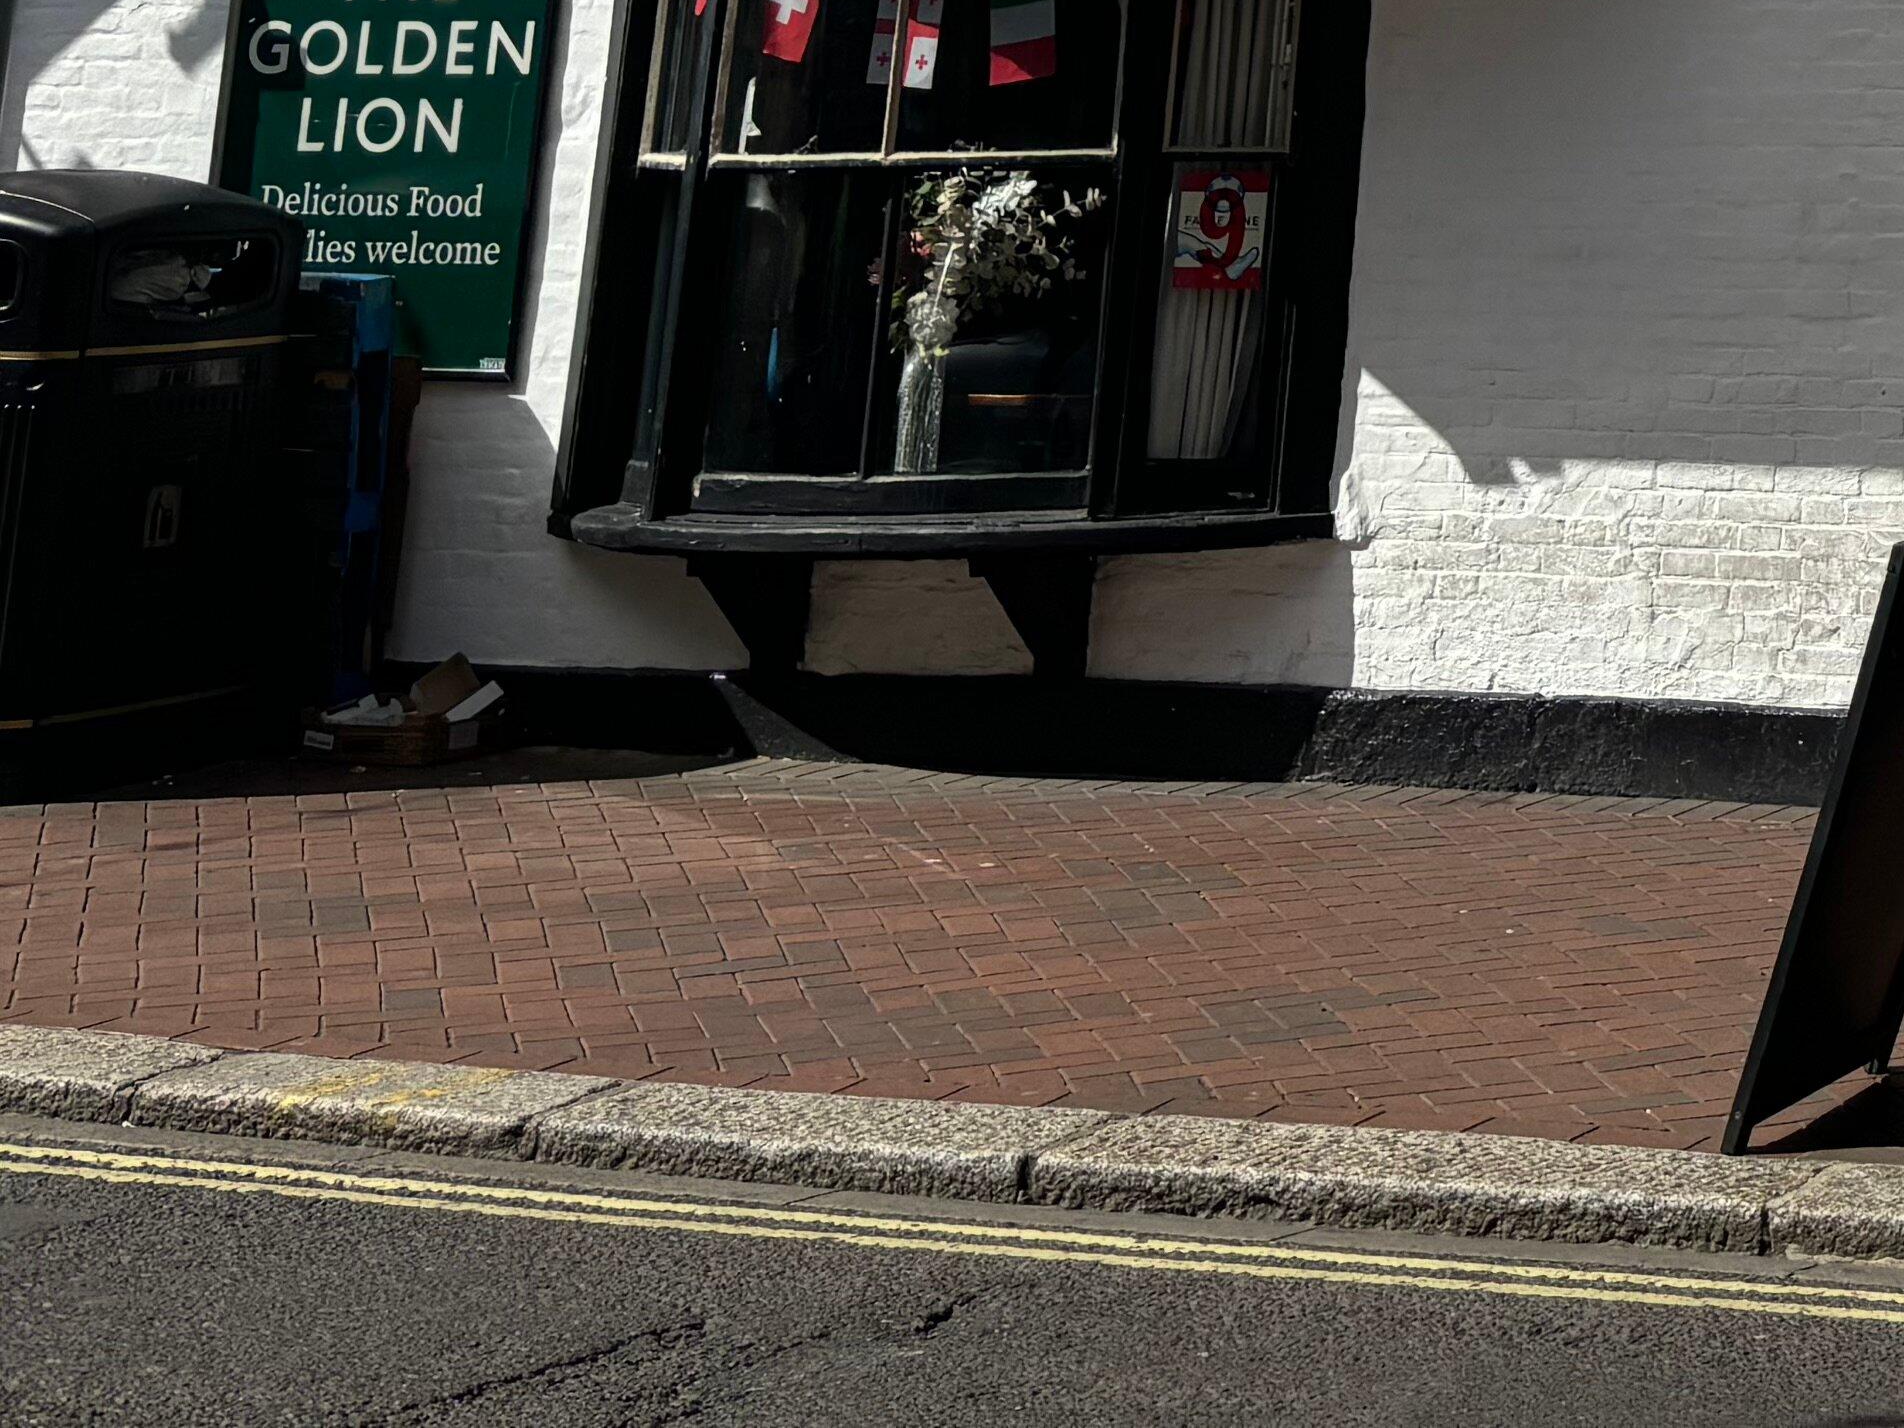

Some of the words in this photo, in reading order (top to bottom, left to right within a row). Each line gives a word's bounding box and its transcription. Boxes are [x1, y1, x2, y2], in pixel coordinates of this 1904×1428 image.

[248, 20, 536, 76] GOLDEN
[296, 97, 464, 153] LION
[261, 182, 400, 217] Delicious
[406, 183, 484, 218] Food
[305, 229, 356, 264] lies
[364, 230, 501, 266] welcome
